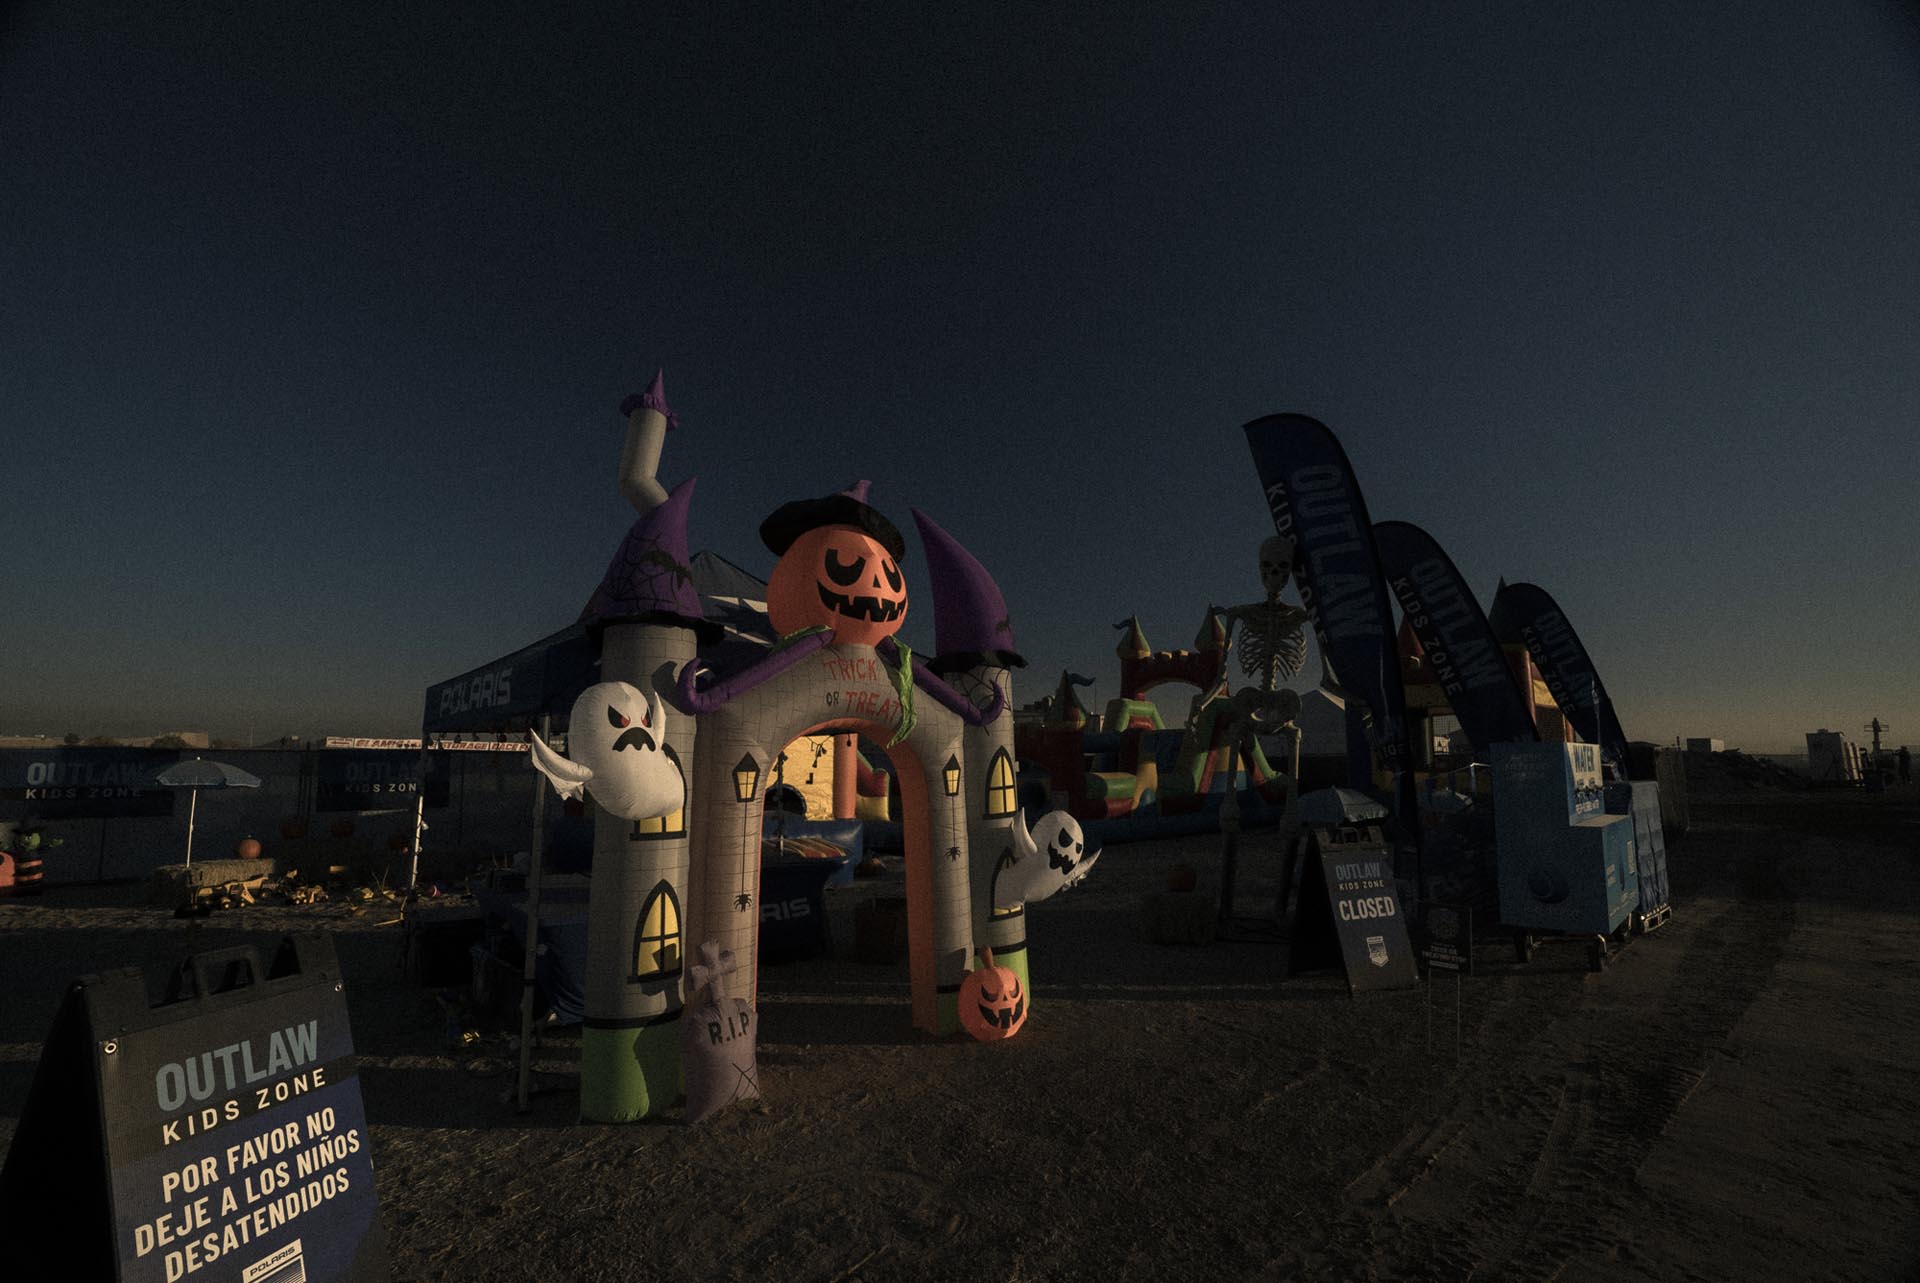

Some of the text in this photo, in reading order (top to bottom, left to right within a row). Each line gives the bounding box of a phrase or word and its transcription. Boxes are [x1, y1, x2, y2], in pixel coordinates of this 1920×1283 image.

[1290, 464, 1384, 640] OUTLAW
[1393, 577, 1463, 696] KIDS ZONE
[1410, 558, 1506, 690] OUTLAW
[440, 667, 513, 718] POLARIS
[823, 657, 876, 681] TRICK
[1521, 626, 1577, 715] KIDS ZONE
[826, 690, 901, 721] OR TREAT
[25, 787, 144, 800] KIDS ZONE
[26, 762, 144, 785] OUTLAW
[344, 783, 417, 793] KIDS ZON
[1335, 862, 1381, 880] OUTLAW
[1338, 879, 1385, 891] KIDS ZONE
[1338, 896, 1396, 920] CLOSED
[154, 1020, 319, 1112] OUTLAW
[162, 1067, 326, 1146] KIDS ZONE
[162, 1106, 336, 1204] POR FAVOR NO
[134, 1128, 361, 1258] DEJE A LOS NIÑOS
[164, 1167, 350, 1283] DESATENDIDOS
[249, 1245, 296, 1278] POLARIS
